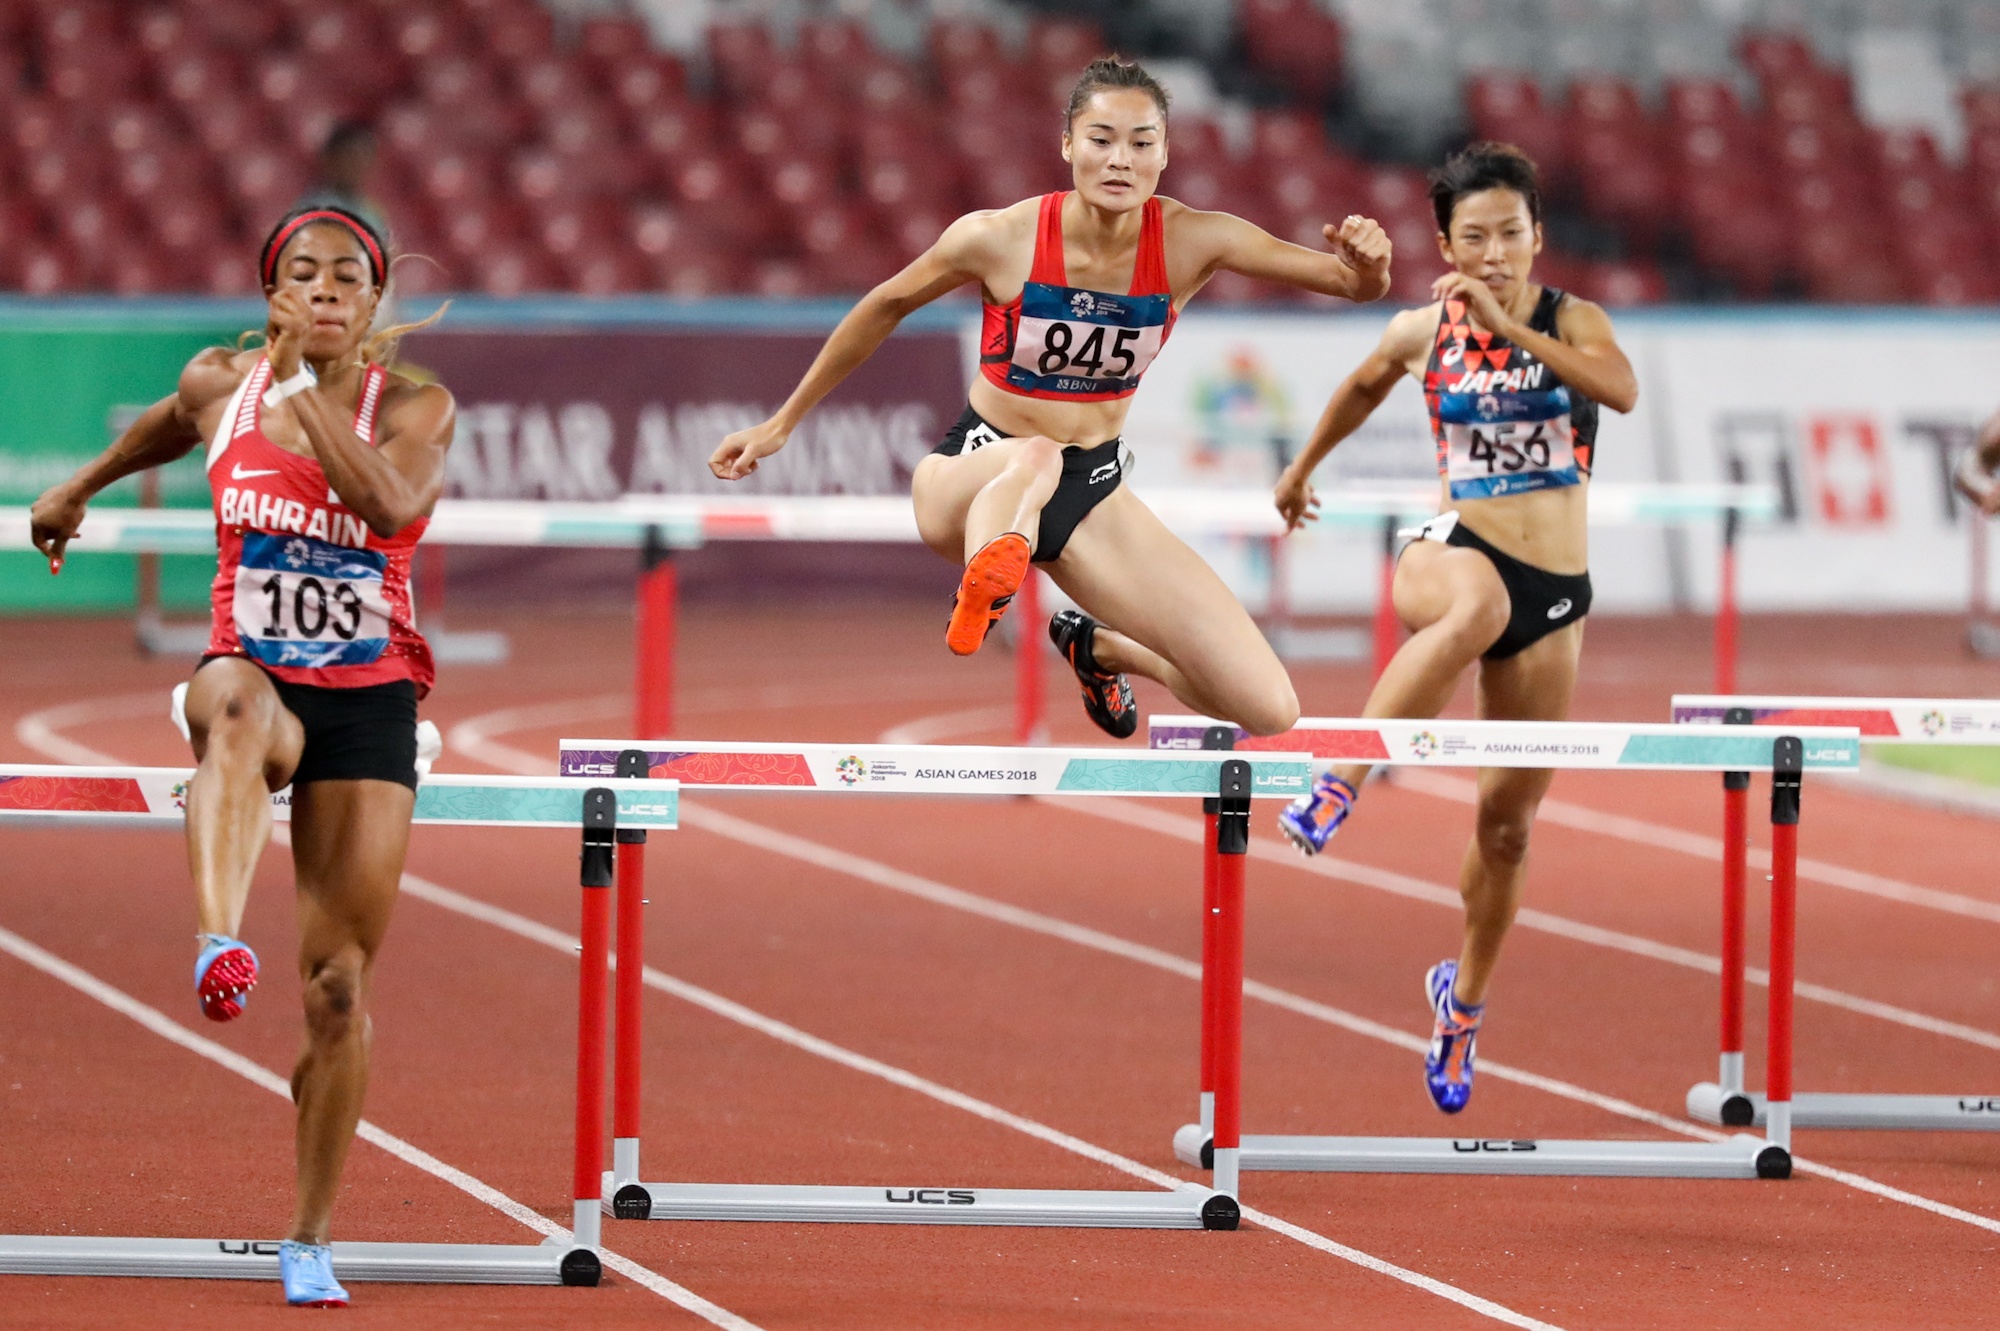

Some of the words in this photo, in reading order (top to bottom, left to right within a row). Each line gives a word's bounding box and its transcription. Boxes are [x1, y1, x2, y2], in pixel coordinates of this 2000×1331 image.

[1038, 322, 1140, 377] 845
[1448, 363, 1544, 394] JAPAN
[1070, 381, 1097, 391] BNI
[1470, 424, 1550, 473] 456
[221, 487, 368, 549] BAHRAIN
[262, 573, 362, 640] 103
[1157, 738, 1202, 749] UCS
[1485, 743, 1522, 754] ASIAN
[1525, 744, 1568, 755] GAMES
[1571, 745, 1599, 755] 2018
[1806, 749, 1851, 761] UCS
[568, 764, 616, 775] UCS
[871, 769, 907, 777] Palembang
[915, 769, 955, 779] ASIAN
[958, 769, 1004, 780] GAMES
[1007, 770, 1037, 781] 2018
[1256, 775, 1303, 786] UCS
[618, 804, 669, 816] UCS
[1958, 1100, 2000, 1112] UC
[1453, 1140, 1537, 1152] UCS
[886, 1189, 976, 1205] UCS
[219, 1241, 281, 1255] UC
